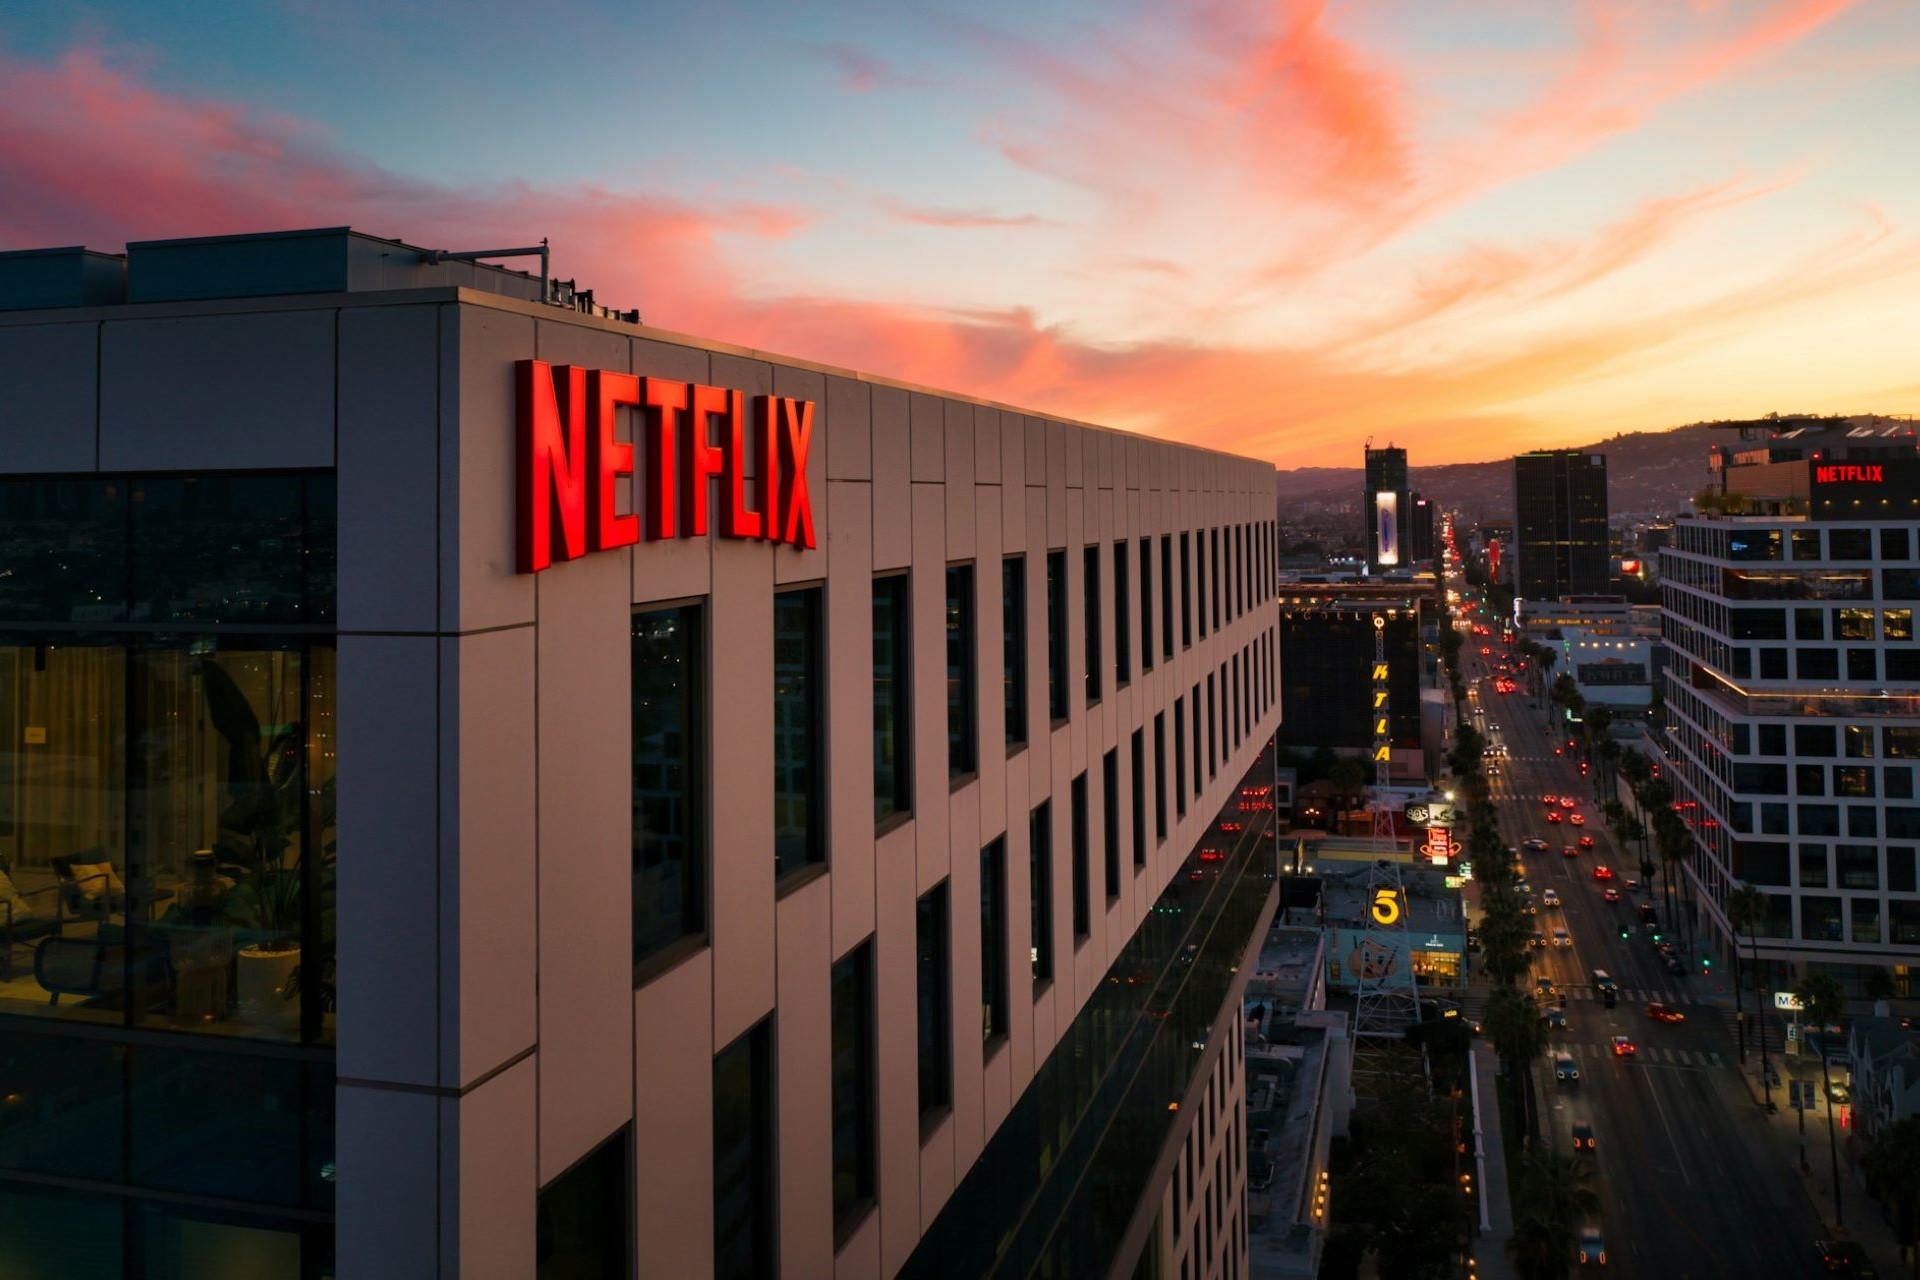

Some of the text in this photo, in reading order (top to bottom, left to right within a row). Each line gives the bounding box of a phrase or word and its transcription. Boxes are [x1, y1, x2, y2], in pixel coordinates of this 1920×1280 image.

[516, 359, 816, 574] NETFLIX
[1816, 464, 1883, 483] NETFLIX
[1372, 664, 1391, 761] KTLA
[1406, 808, 1429, 821] 805
[1372, 889, 1400, 925] 5
